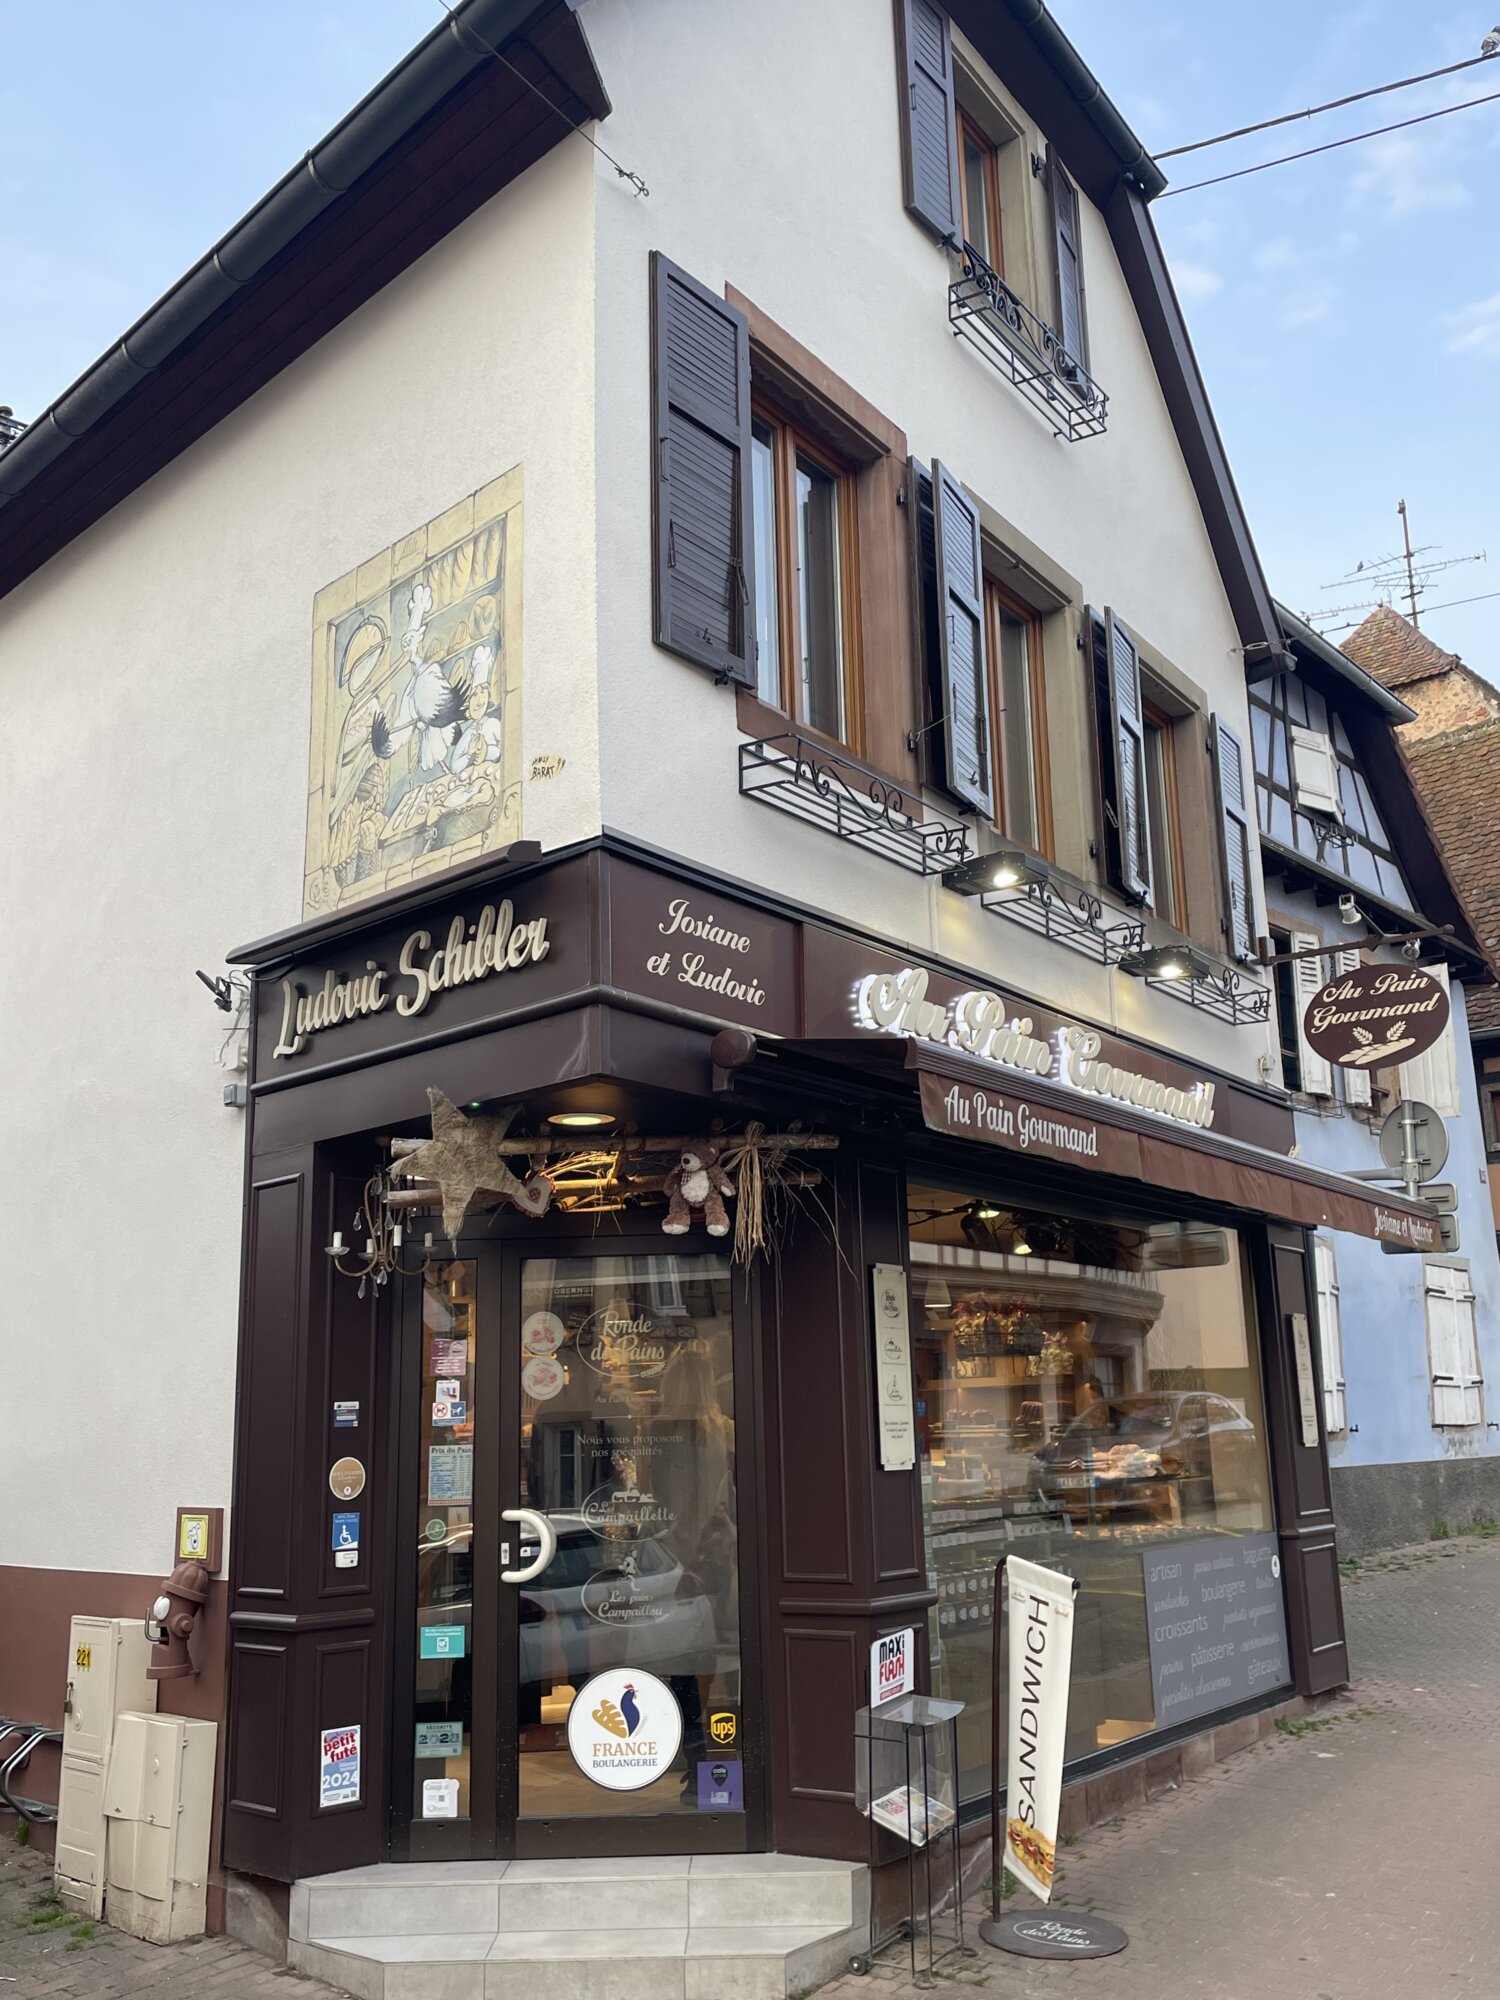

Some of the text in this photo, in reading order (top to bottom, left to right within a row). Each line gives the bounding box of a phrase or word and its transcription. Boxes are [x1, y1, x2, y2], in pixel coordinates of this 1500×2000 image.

[658, 899, 750, 953] Josiane
[273, 899, 550, 1060] Ludovic Schibler
[646, 952, 766, 1006] et Ludovic
[1323, 973, 1431, 1003] Au Pain
[1311, 992, 1441, 1034] Gourmand
[859, 968, 1215, 1128] Au Pain Gourmand
[944, 1085, 1098, 1157] Au Pain Gourmand
[600, 1310, 653, 1338] Ronde
[616, 1334, 665, 1365] Pains
[446, 1446, 456, 1454] du
[457, 1446, 472, 1454] Pain
[577, 1434, 684, 1447] Nous vous proposons
[590, 1448, 609, 1458] nos
[1150, 1561, 1182, 1582] artisan
[598, 1601, 664, 1620] Campaillou
[1155, 1615, 1208, 1642] croissants
[77, 1648, 91, 1666] 221
[1018, 1594, 1050, 1830] SANDWICH
[713, 1722, 734, 1739] ups
[323, 1732, 356, 1756] petit
[330, 1744, 358, 1763] futé
[592, 1741, 658, 1757] FRANCE
[592, 1758, 659, 1769] BOULANGERIE
[323, 1771, 358, 1789] 2024
